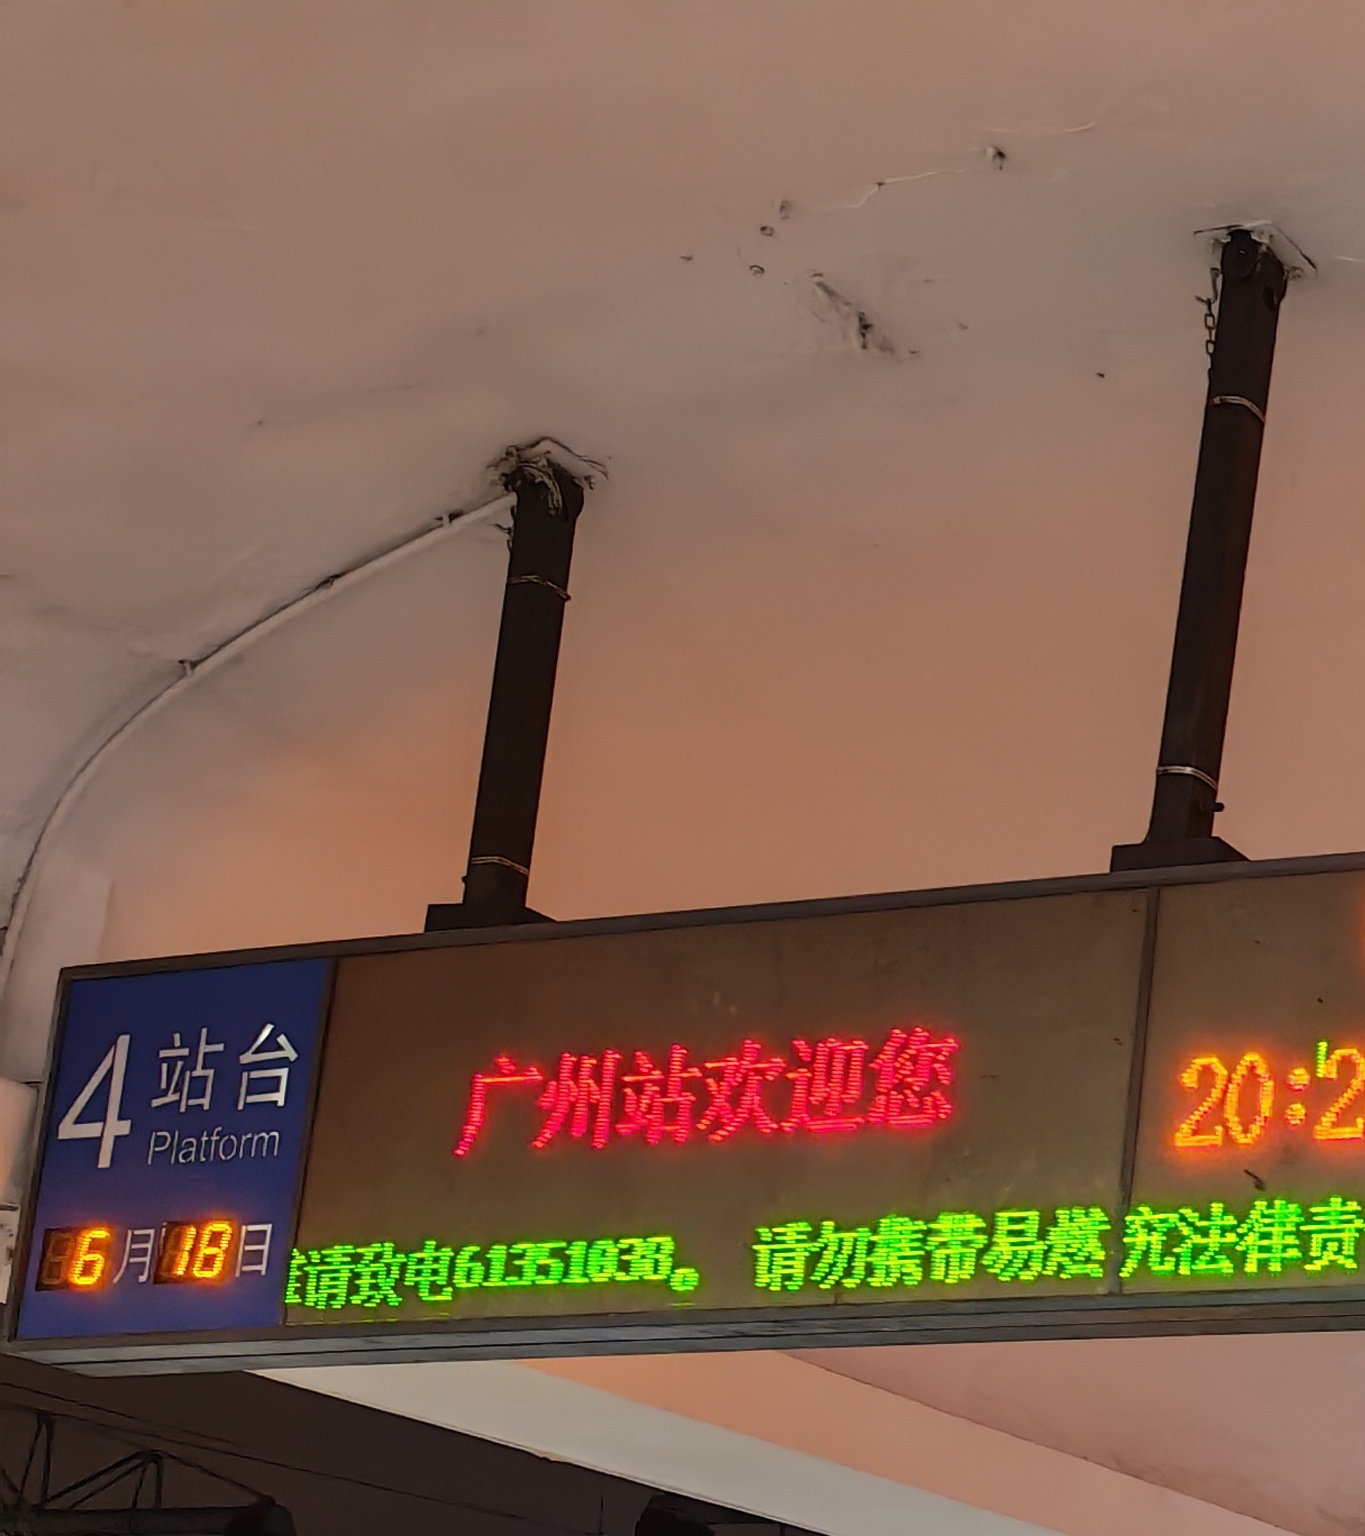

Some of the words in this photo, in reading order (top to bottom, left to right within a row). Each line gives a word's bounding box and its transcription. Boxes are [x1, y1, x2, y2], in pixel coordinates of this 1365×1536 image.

[57, 1033, 132, 1169] 4
[150, 1022, 299, 1113] 站台
[147, 1126, 281, 1166] Platform
[453, 1025, 960, 1158] 广州站欢迎您
[752, 1206, 1112, 1292] 请勿携带易燃
